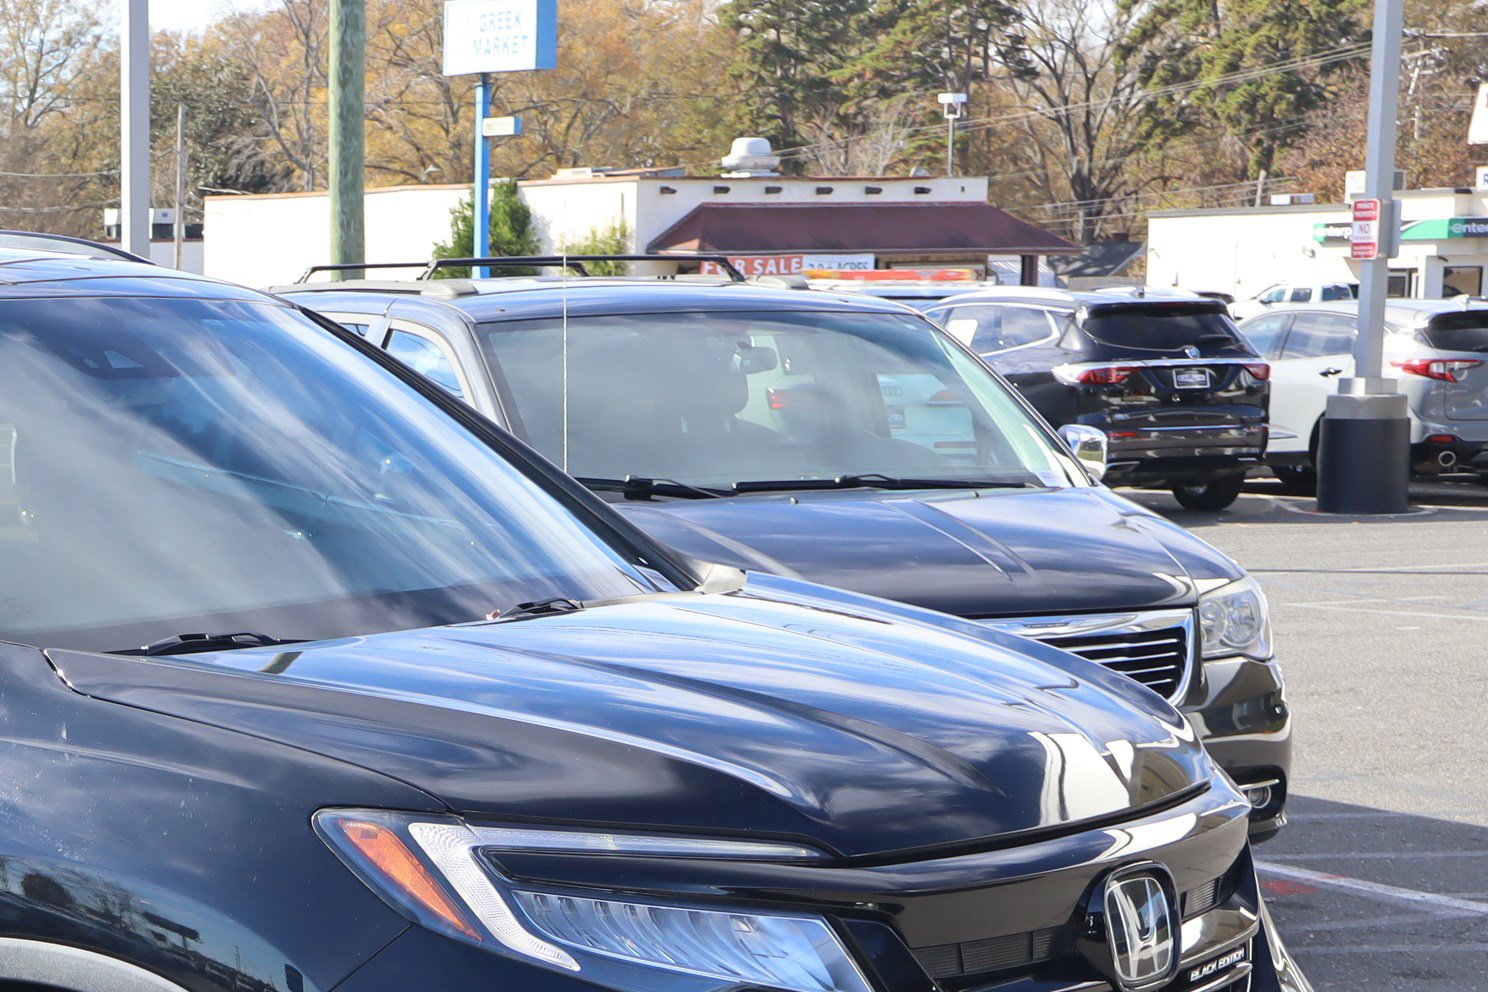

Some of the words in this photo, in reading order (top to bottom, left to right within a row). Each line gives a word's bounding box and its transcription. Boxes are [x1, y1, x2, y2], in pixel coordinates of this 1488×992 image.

[479, 9, 522, 32] GREEK
[473, 34, 528, 56] MARKET
[1313, 226, 1352, 239] enterp
[1358, 223, 1371, 234] NO
[753, 257, 801, 276] SALE
[1190, 960, 1218, 981] BLACK
[1218, 947, 1245, 970] EDITION
